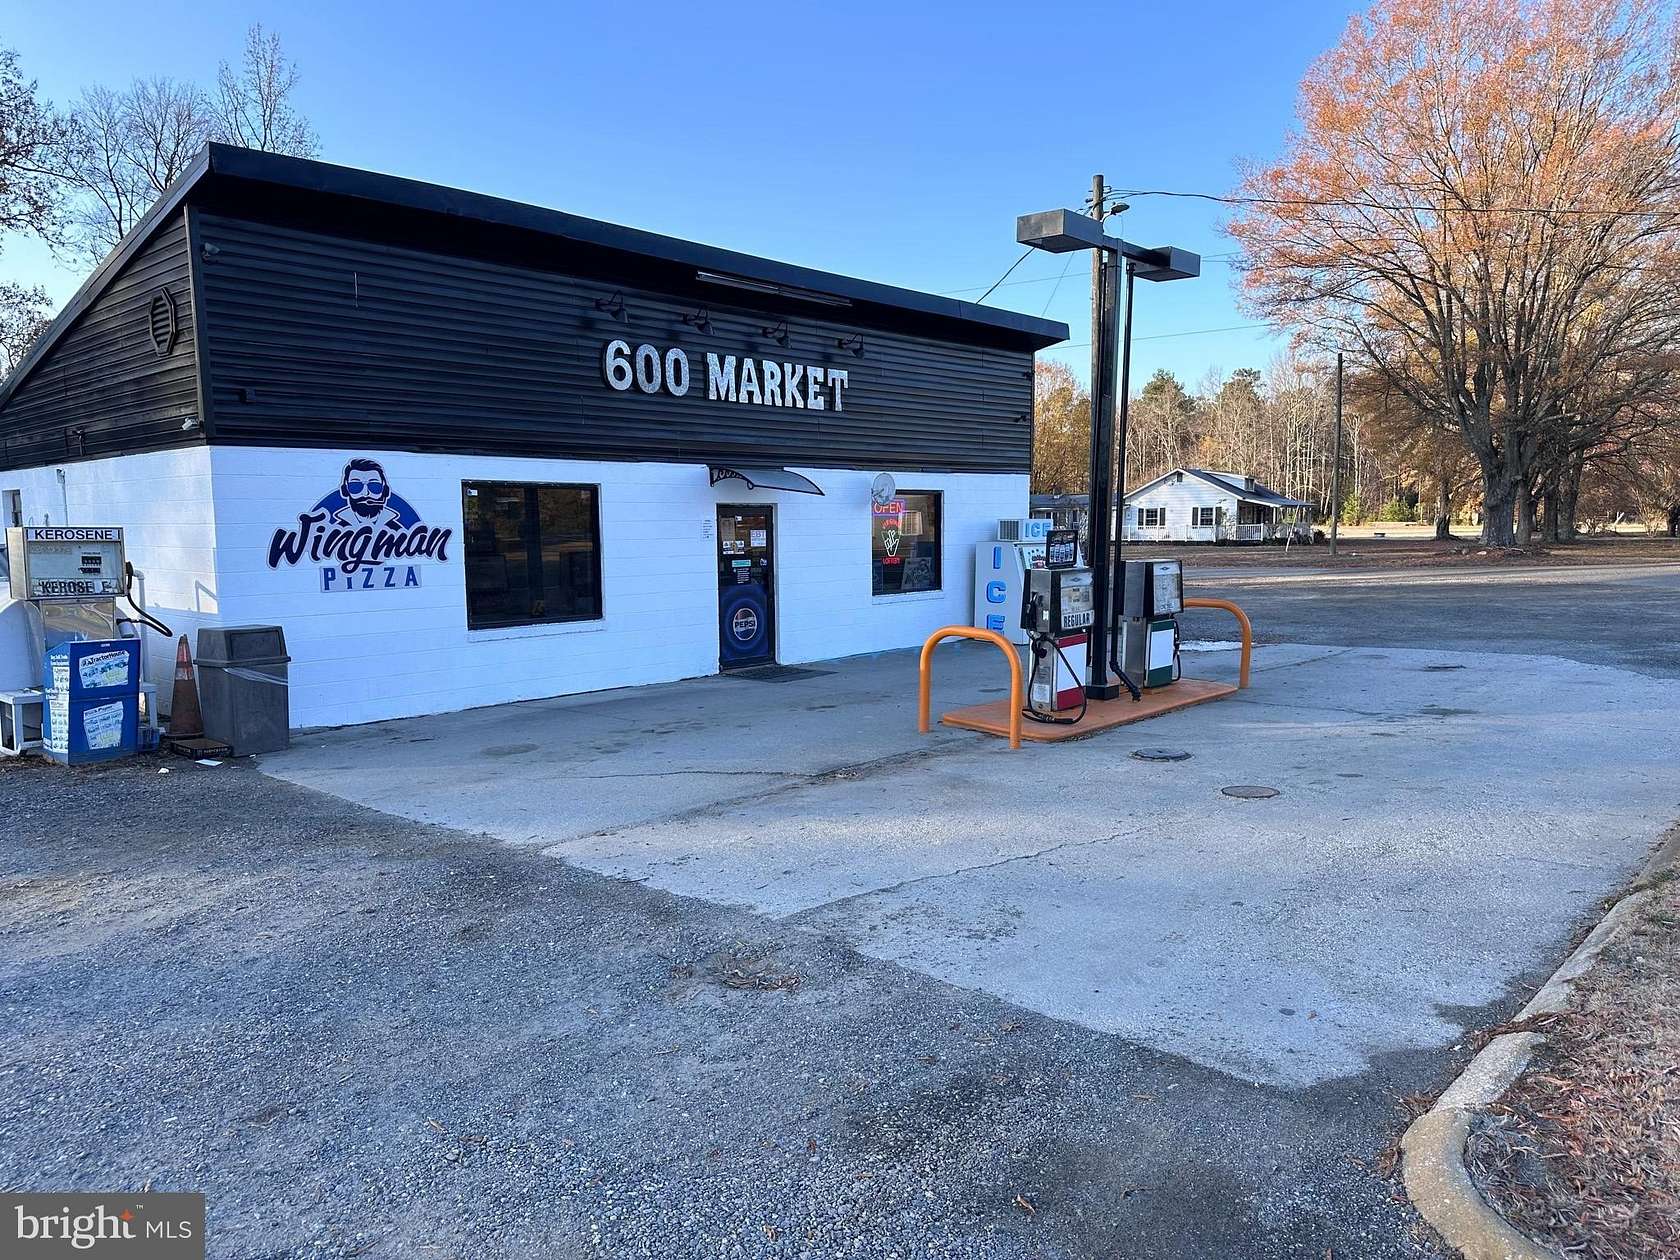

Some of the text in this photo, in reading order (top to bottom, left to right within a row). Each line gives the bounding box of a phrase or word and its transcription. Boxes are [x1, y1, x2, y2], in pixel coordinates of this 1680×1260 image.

[605, 339, 849, 412] 600 MARKET
[34, 529, 113, 540] KEROSENE
[1025, 522, 1052, 538] ICE
[268, 511, 453, 575] Wingman
[323, 566, 419, 591] PIZZA
[986, 546, 1007, 637] ICE
[734, 619, 756, 629] PEPSI
[1063, 612, 1091, 628] REGULAR
